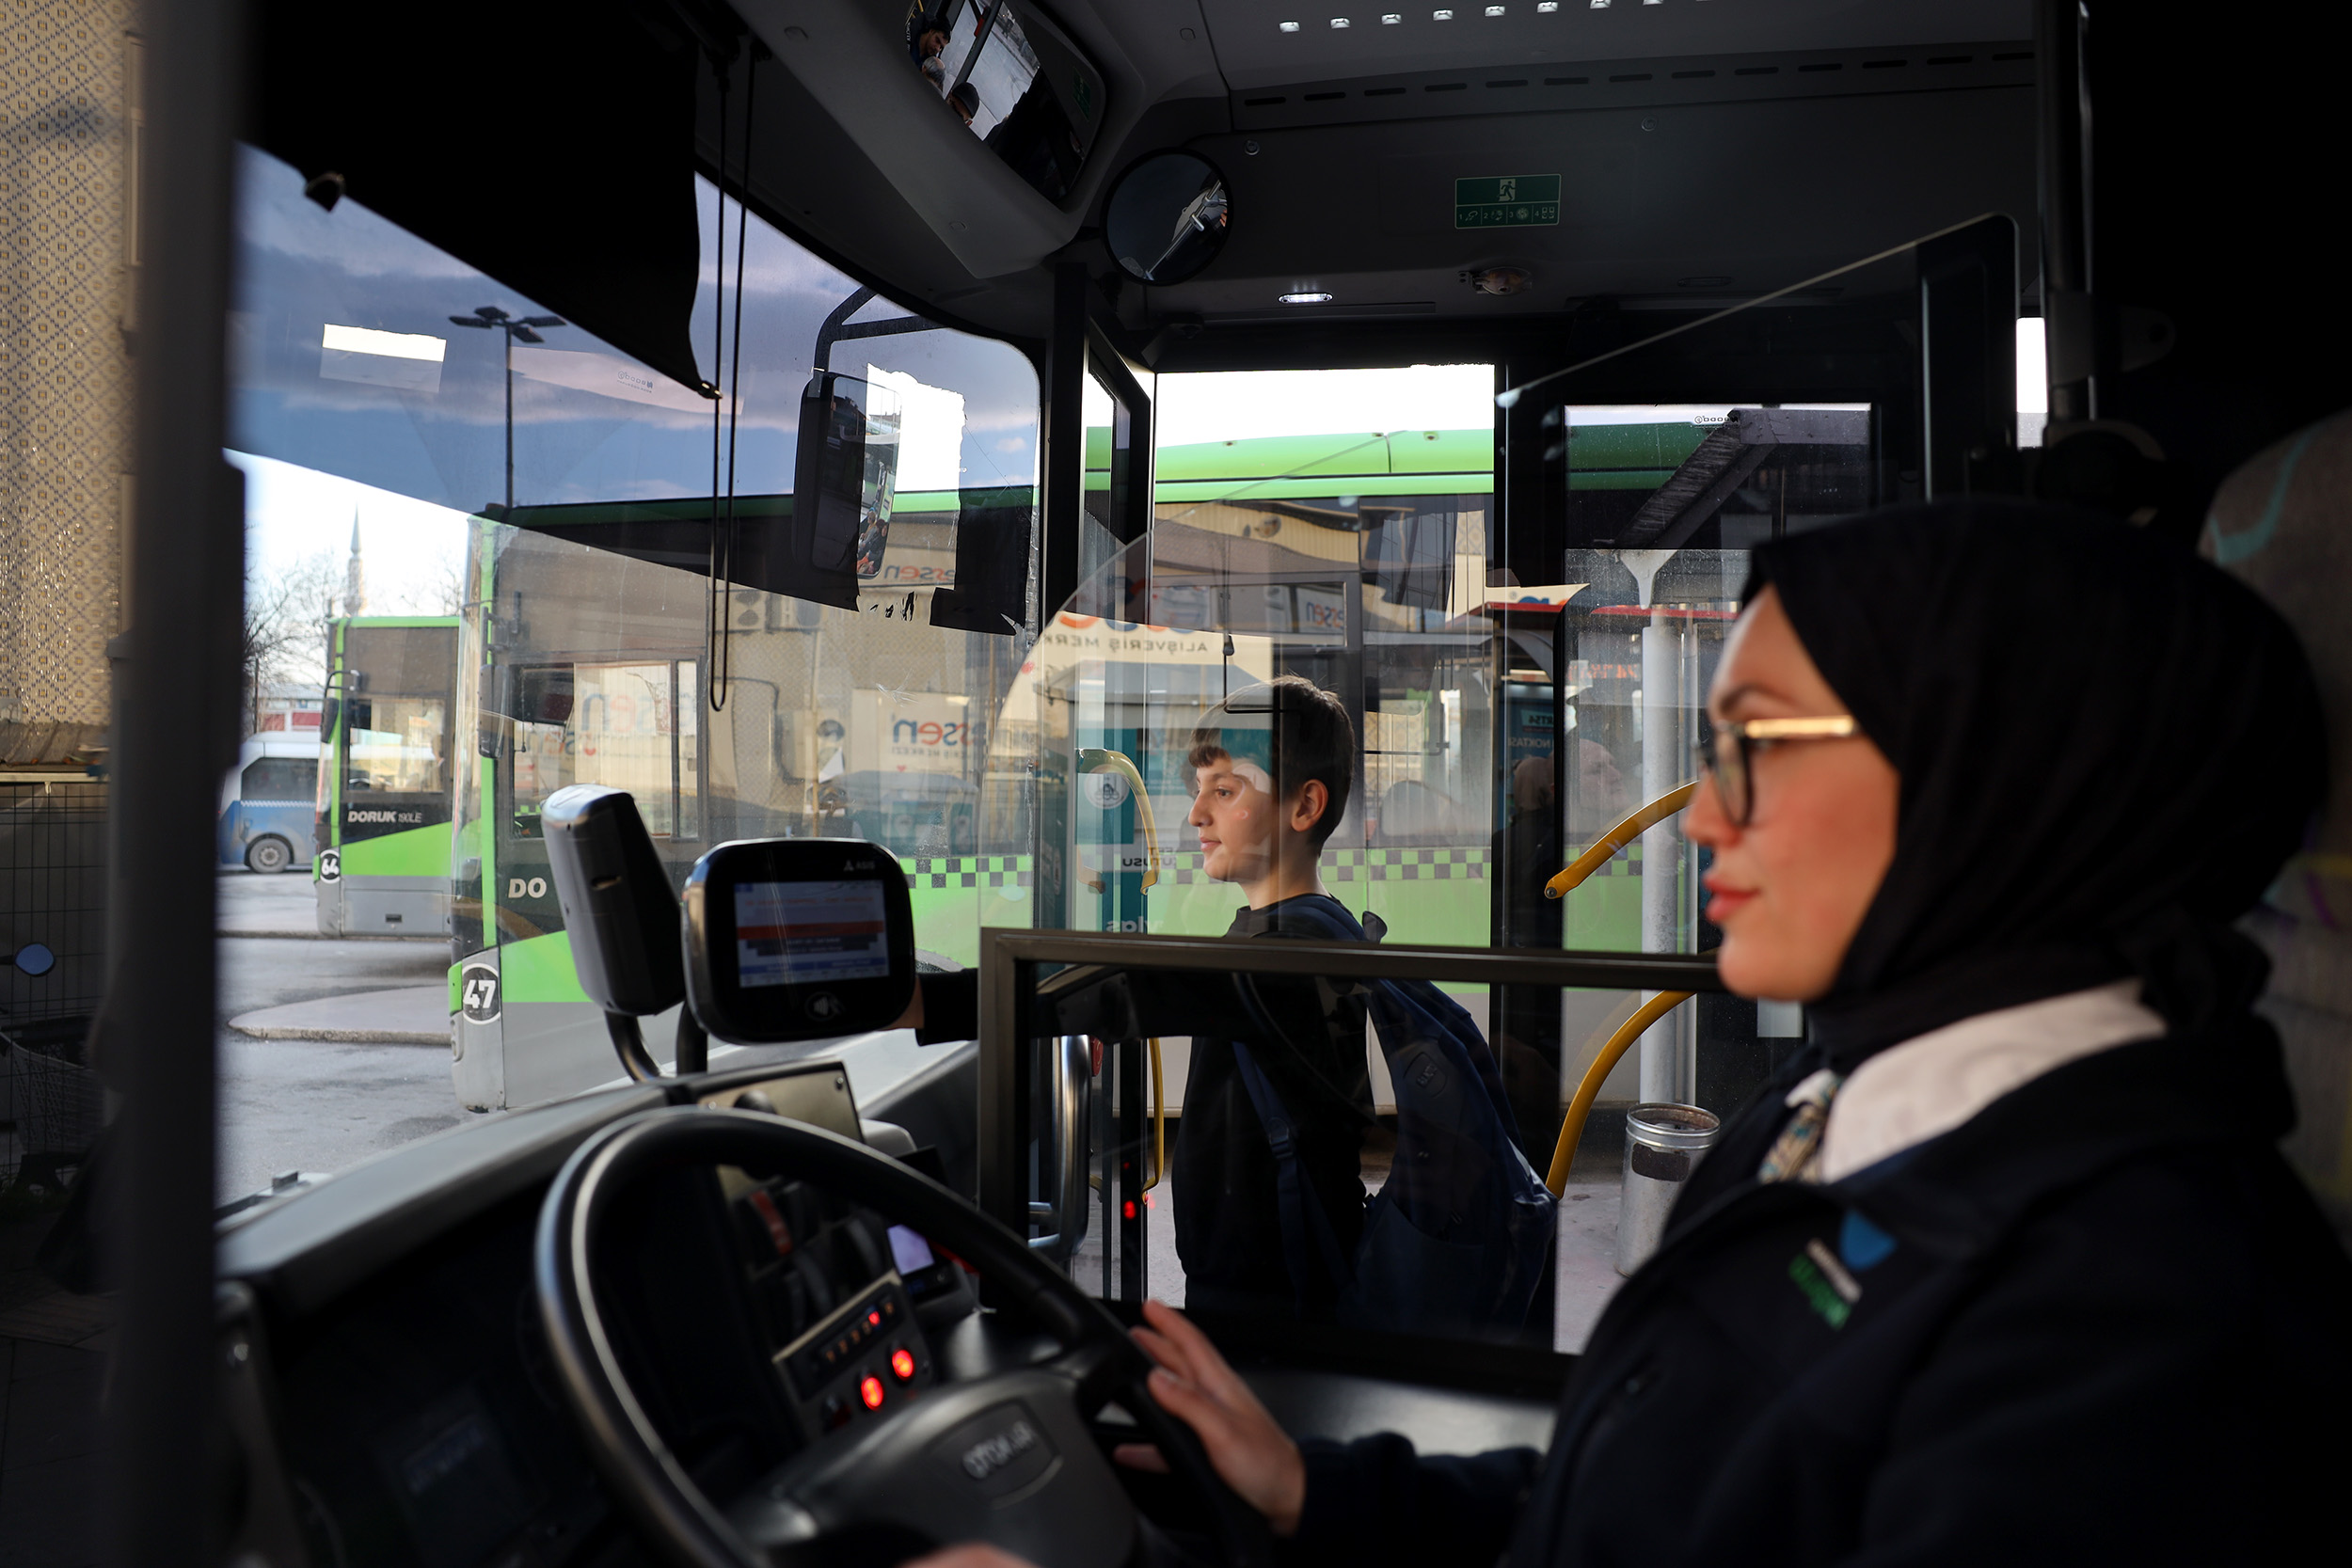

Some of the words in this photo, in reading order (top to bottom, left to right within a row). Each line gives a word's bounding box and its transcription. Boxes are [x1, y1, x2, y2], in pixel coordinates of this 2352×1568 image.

[347, 810, 397, 823] DORUK
[322, 858, 340, 876] 64
[508, 877, 548, 899] DO
[463, 979, 496, 1009] 47
